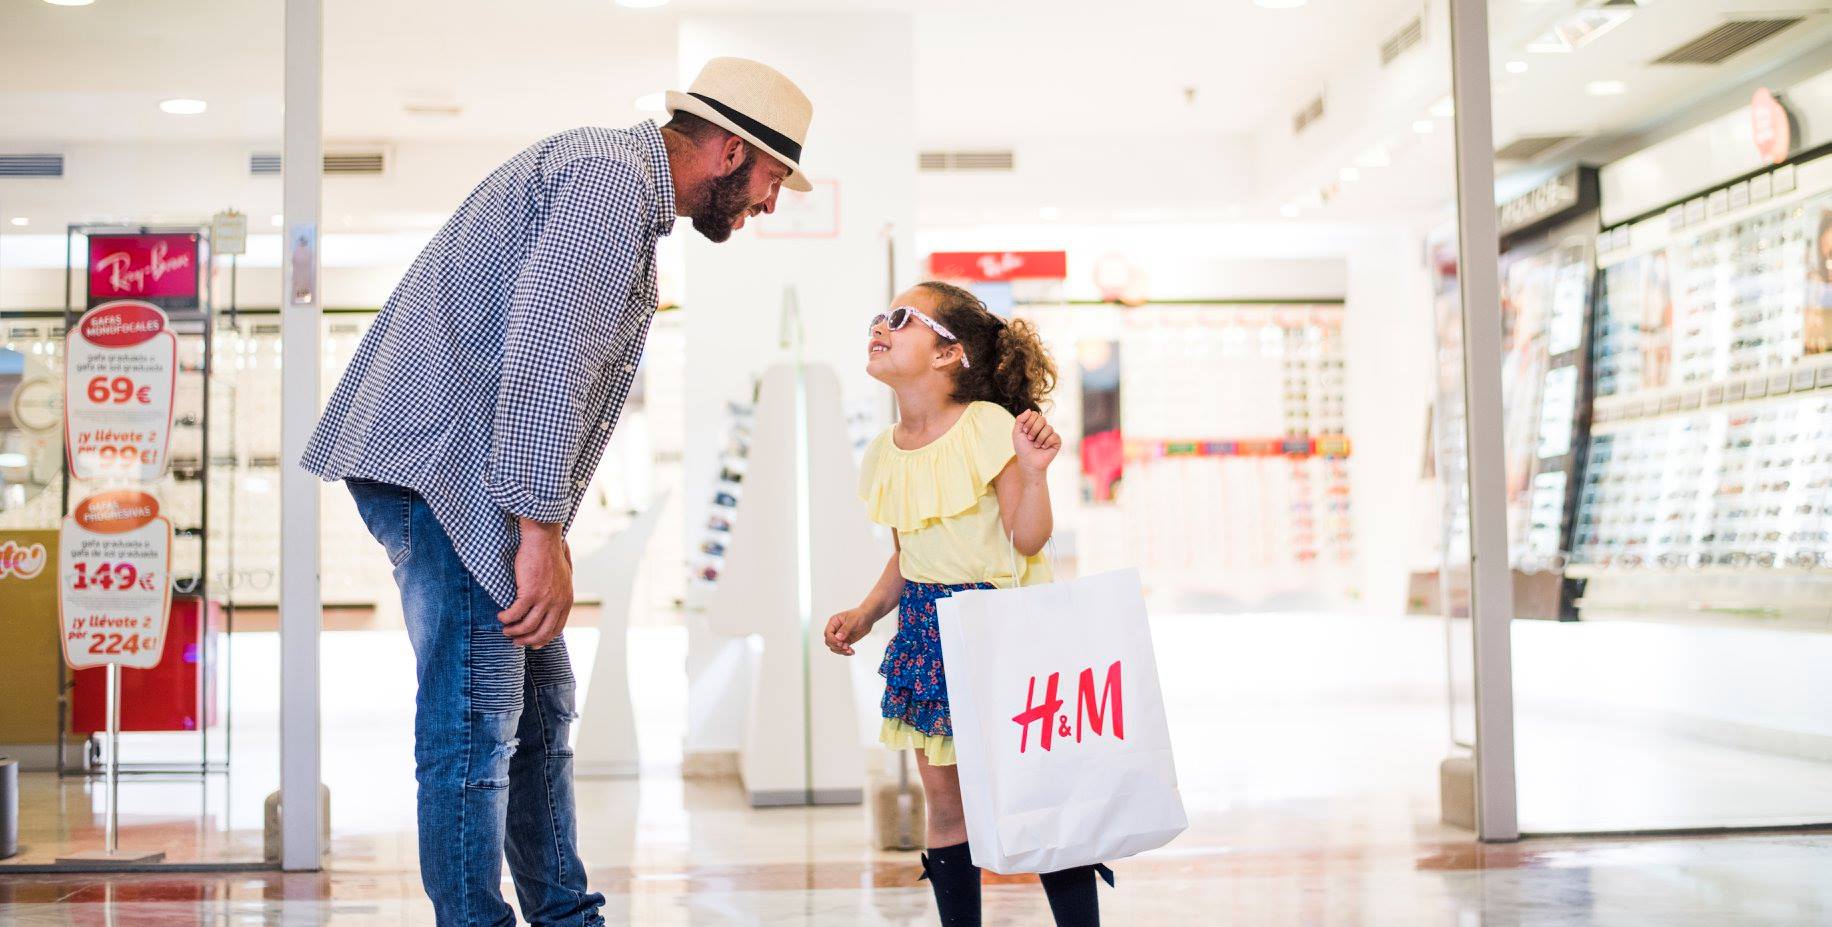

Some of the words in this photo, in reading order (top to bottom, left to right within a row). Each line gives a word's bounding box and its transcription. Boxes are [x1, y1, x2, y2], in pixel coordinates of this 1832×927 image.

[96, 240, 188, 293] Ray-Ban
[86, 320, 160, 337] MONOFOCALES
[87, 375, 152, 405] 69€
[1012, 660, 1124, 754] H&M
